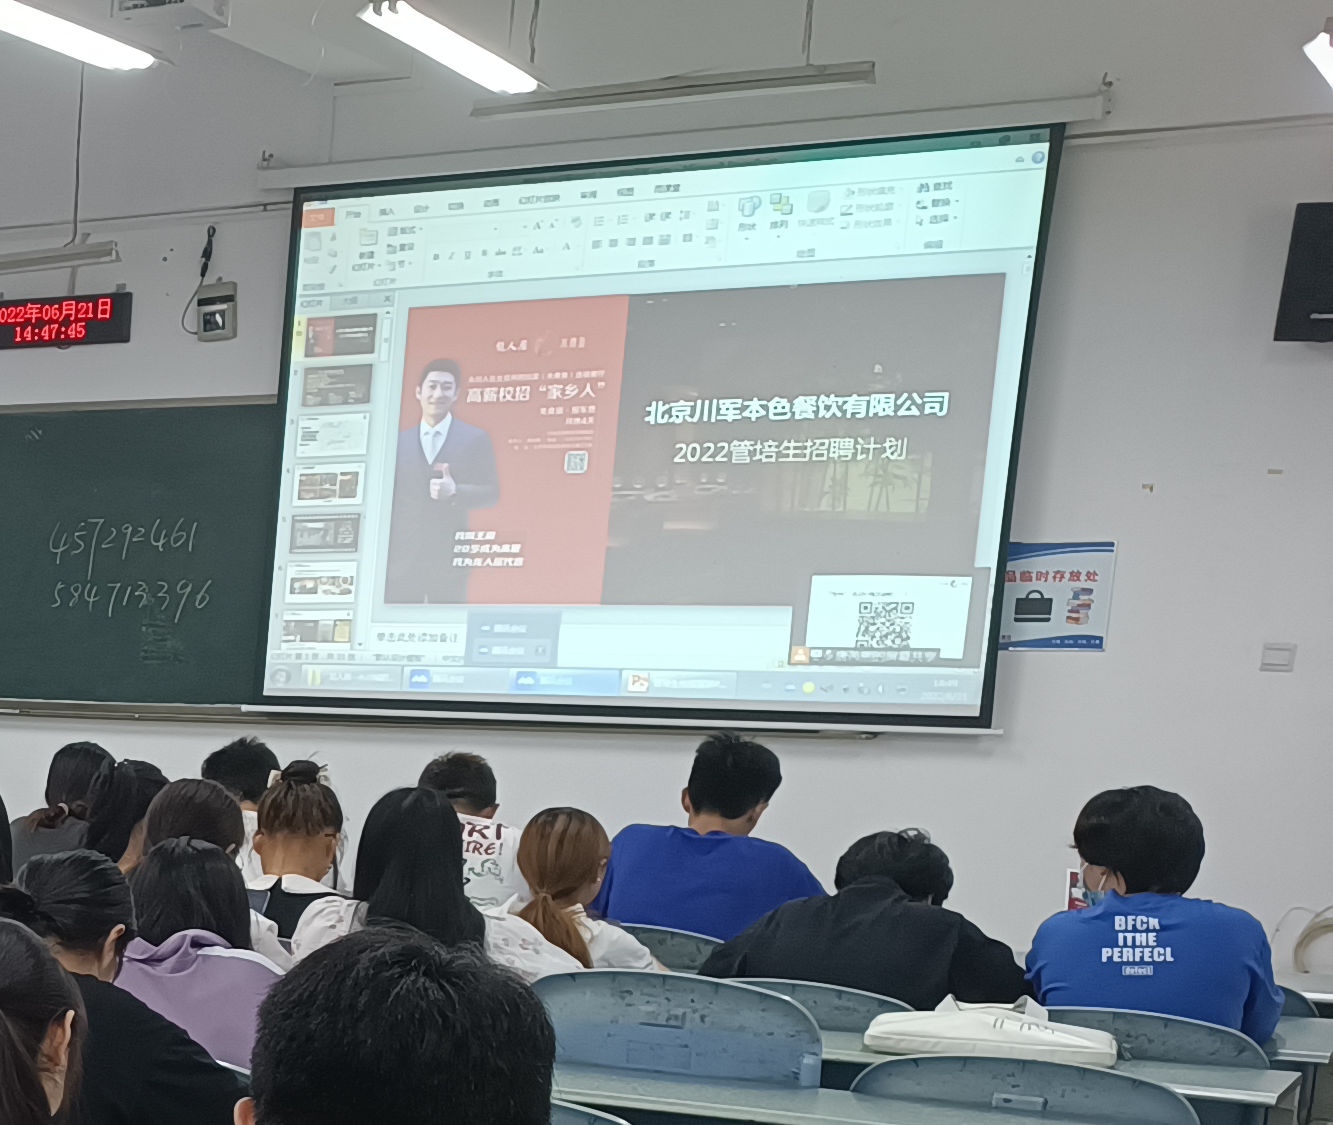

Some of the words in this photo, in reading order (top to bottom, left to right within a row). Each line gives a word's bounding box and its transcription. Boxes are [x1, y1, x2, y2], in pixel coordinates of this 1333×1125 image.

[14, 322, 86, 342] 14:47:45
[644, 391, 950, 425] 北京川军本色餐饮有限公司
[673, 436, 908, 464] 2022管培生招聘计划
[49, 517, 198, 580] 457292461
